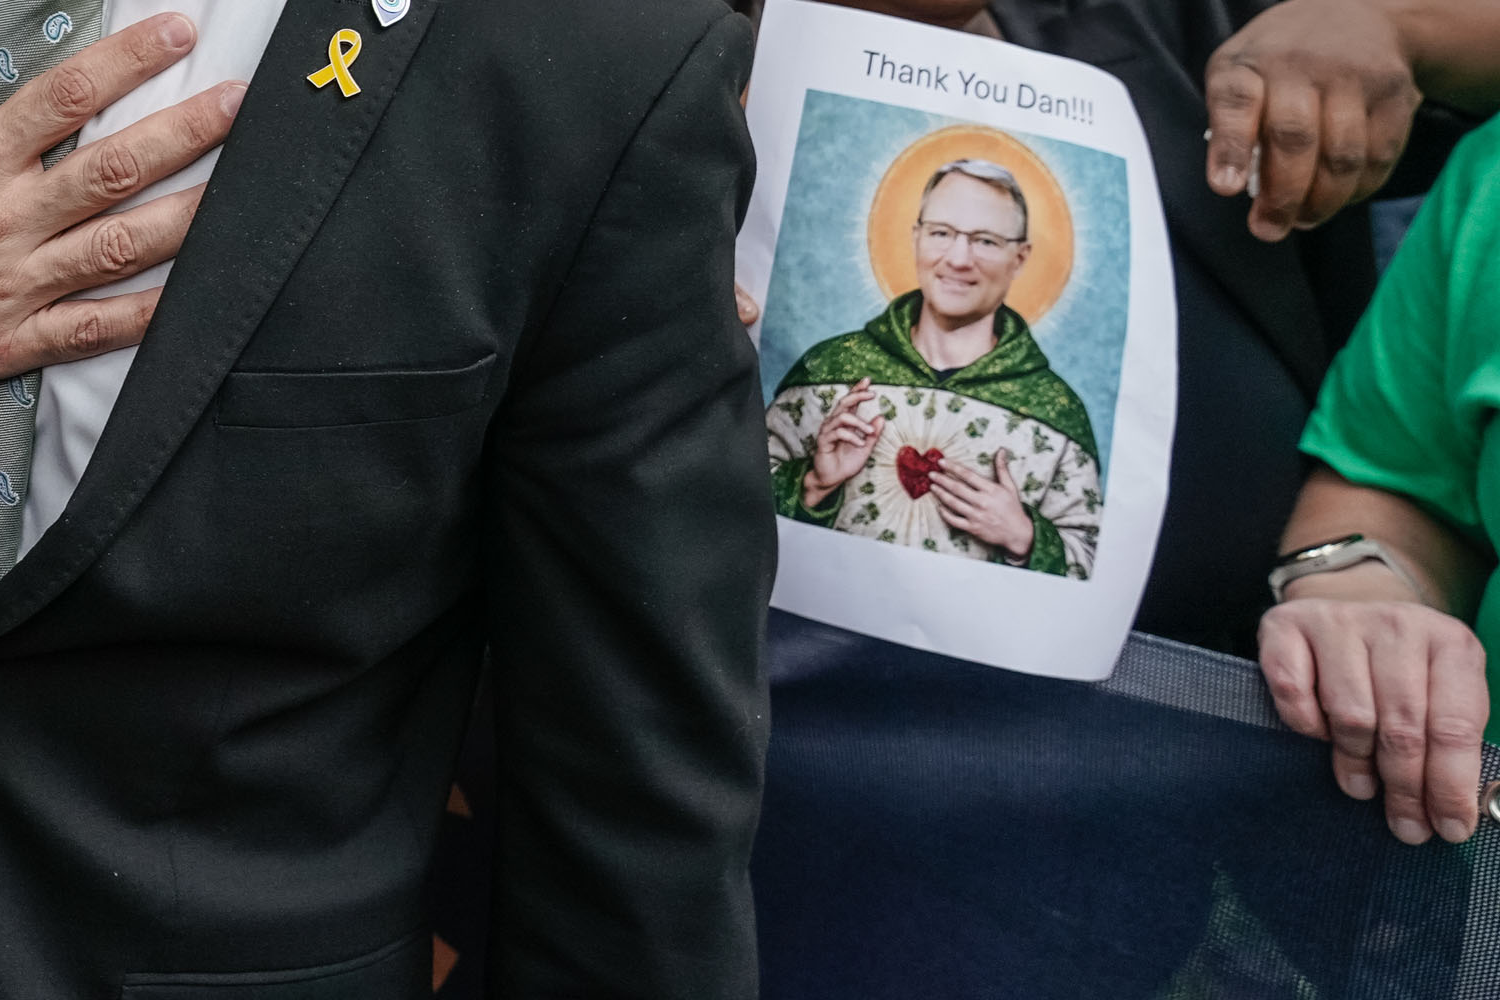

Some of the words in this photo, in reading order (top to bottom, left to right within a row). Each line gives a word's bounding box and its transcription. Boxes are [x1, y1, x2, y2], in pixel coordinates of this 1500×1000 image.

[863, 49, 950, 93] Thank
[957, 70, 1009, 104] You
[1016, 83, 1095, 126] Dan!!!
